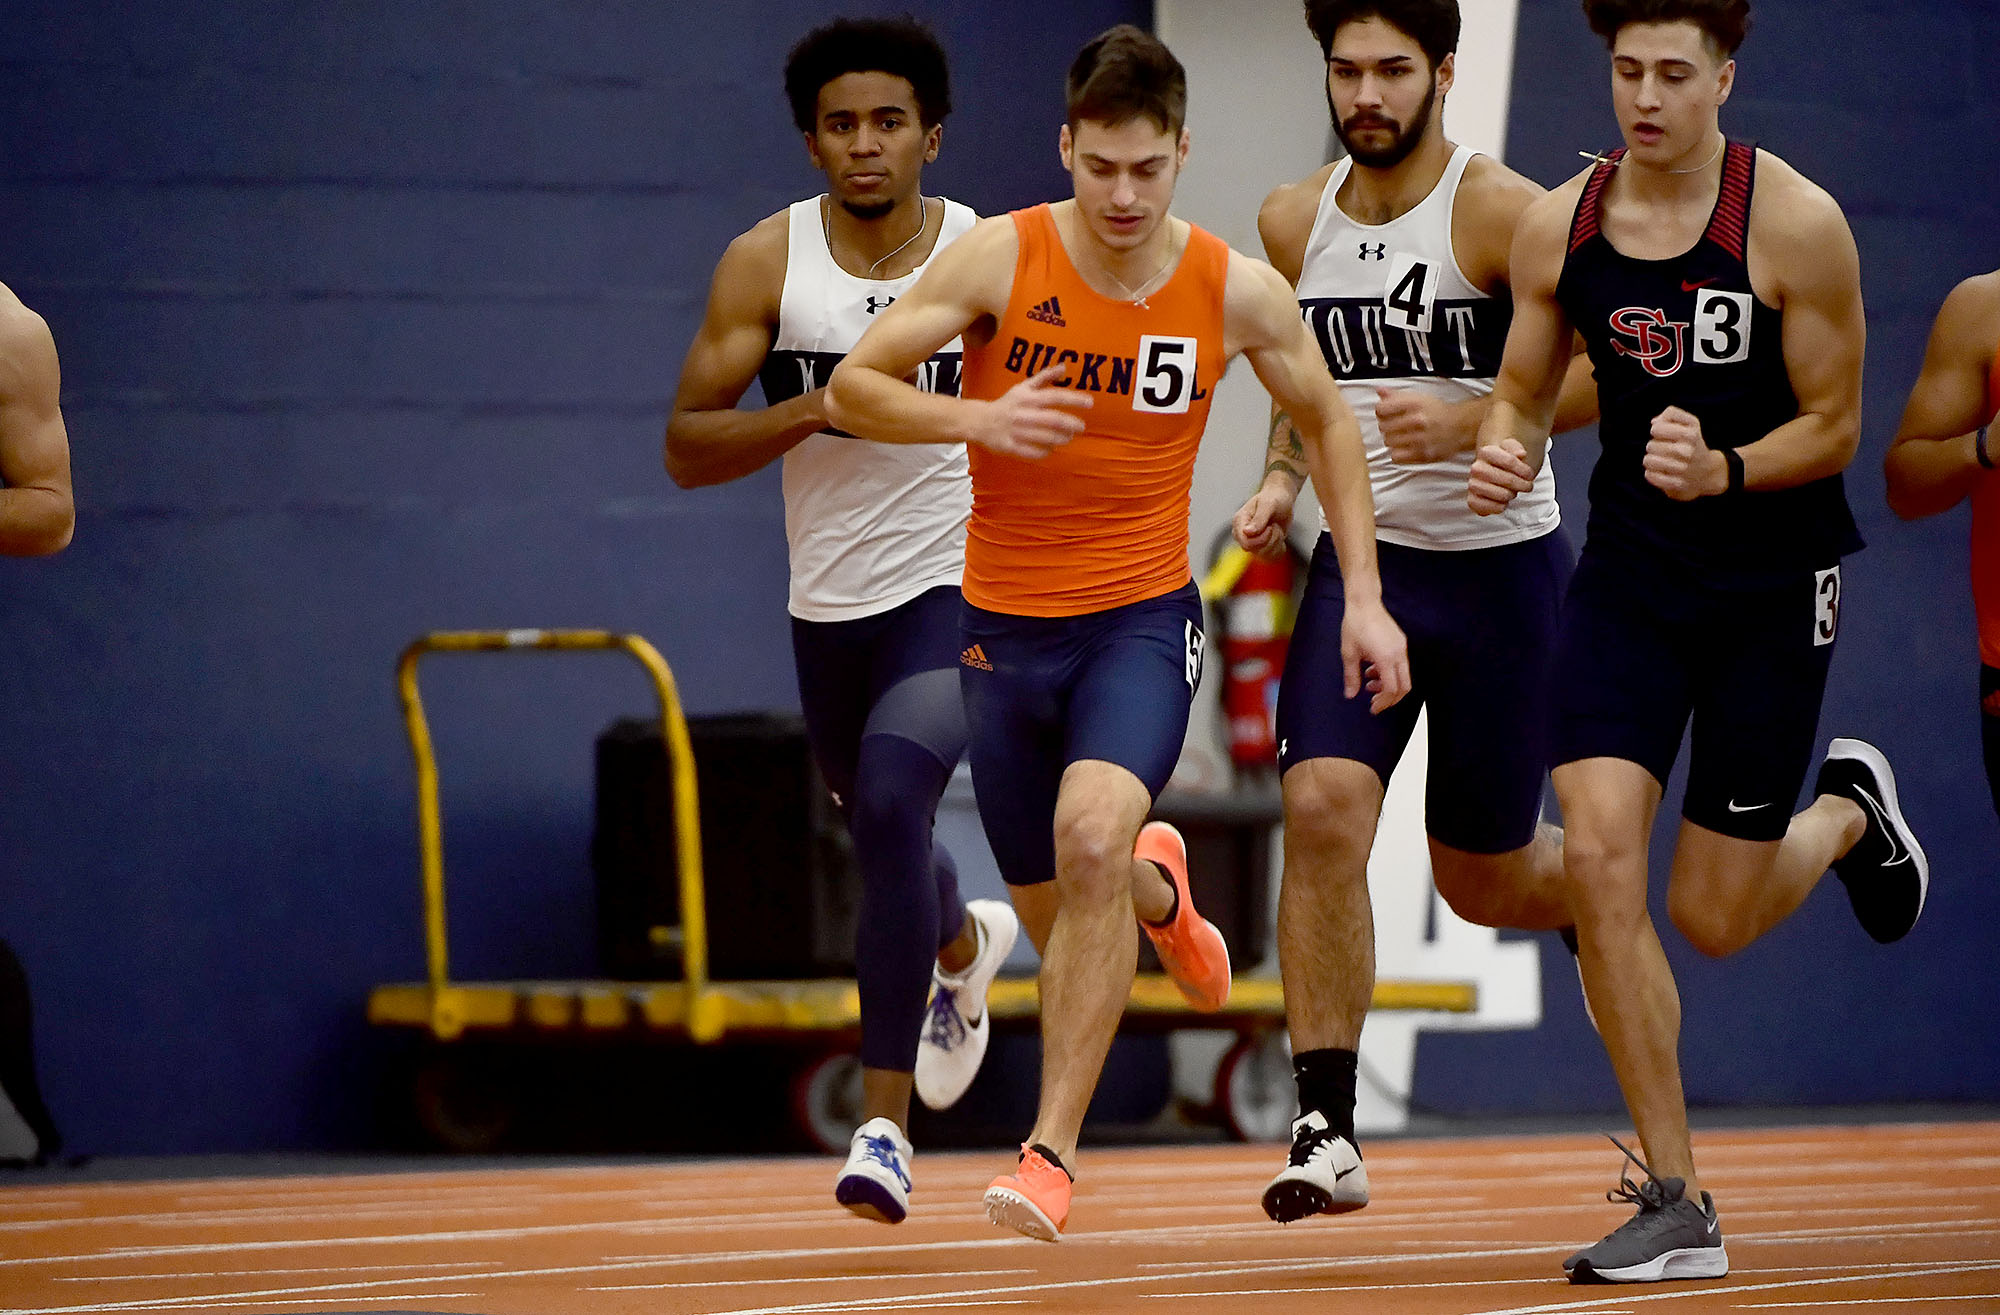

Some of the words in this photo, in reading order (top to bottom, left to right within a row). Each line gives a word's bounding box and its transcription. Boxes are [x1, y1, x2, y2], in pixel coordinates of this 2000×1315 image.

[1026, 310, 1066, 328] adidas
[1388, 261, 1429, 327] 4
[1700, 295, 1741, 360] 3
[1005, 336, 1206, 401] BUCKNL
[1142, 341, 1184, 408] 5
[1819, 573, 1837, 639] 3
[960, 655, 993, 671] adidas
